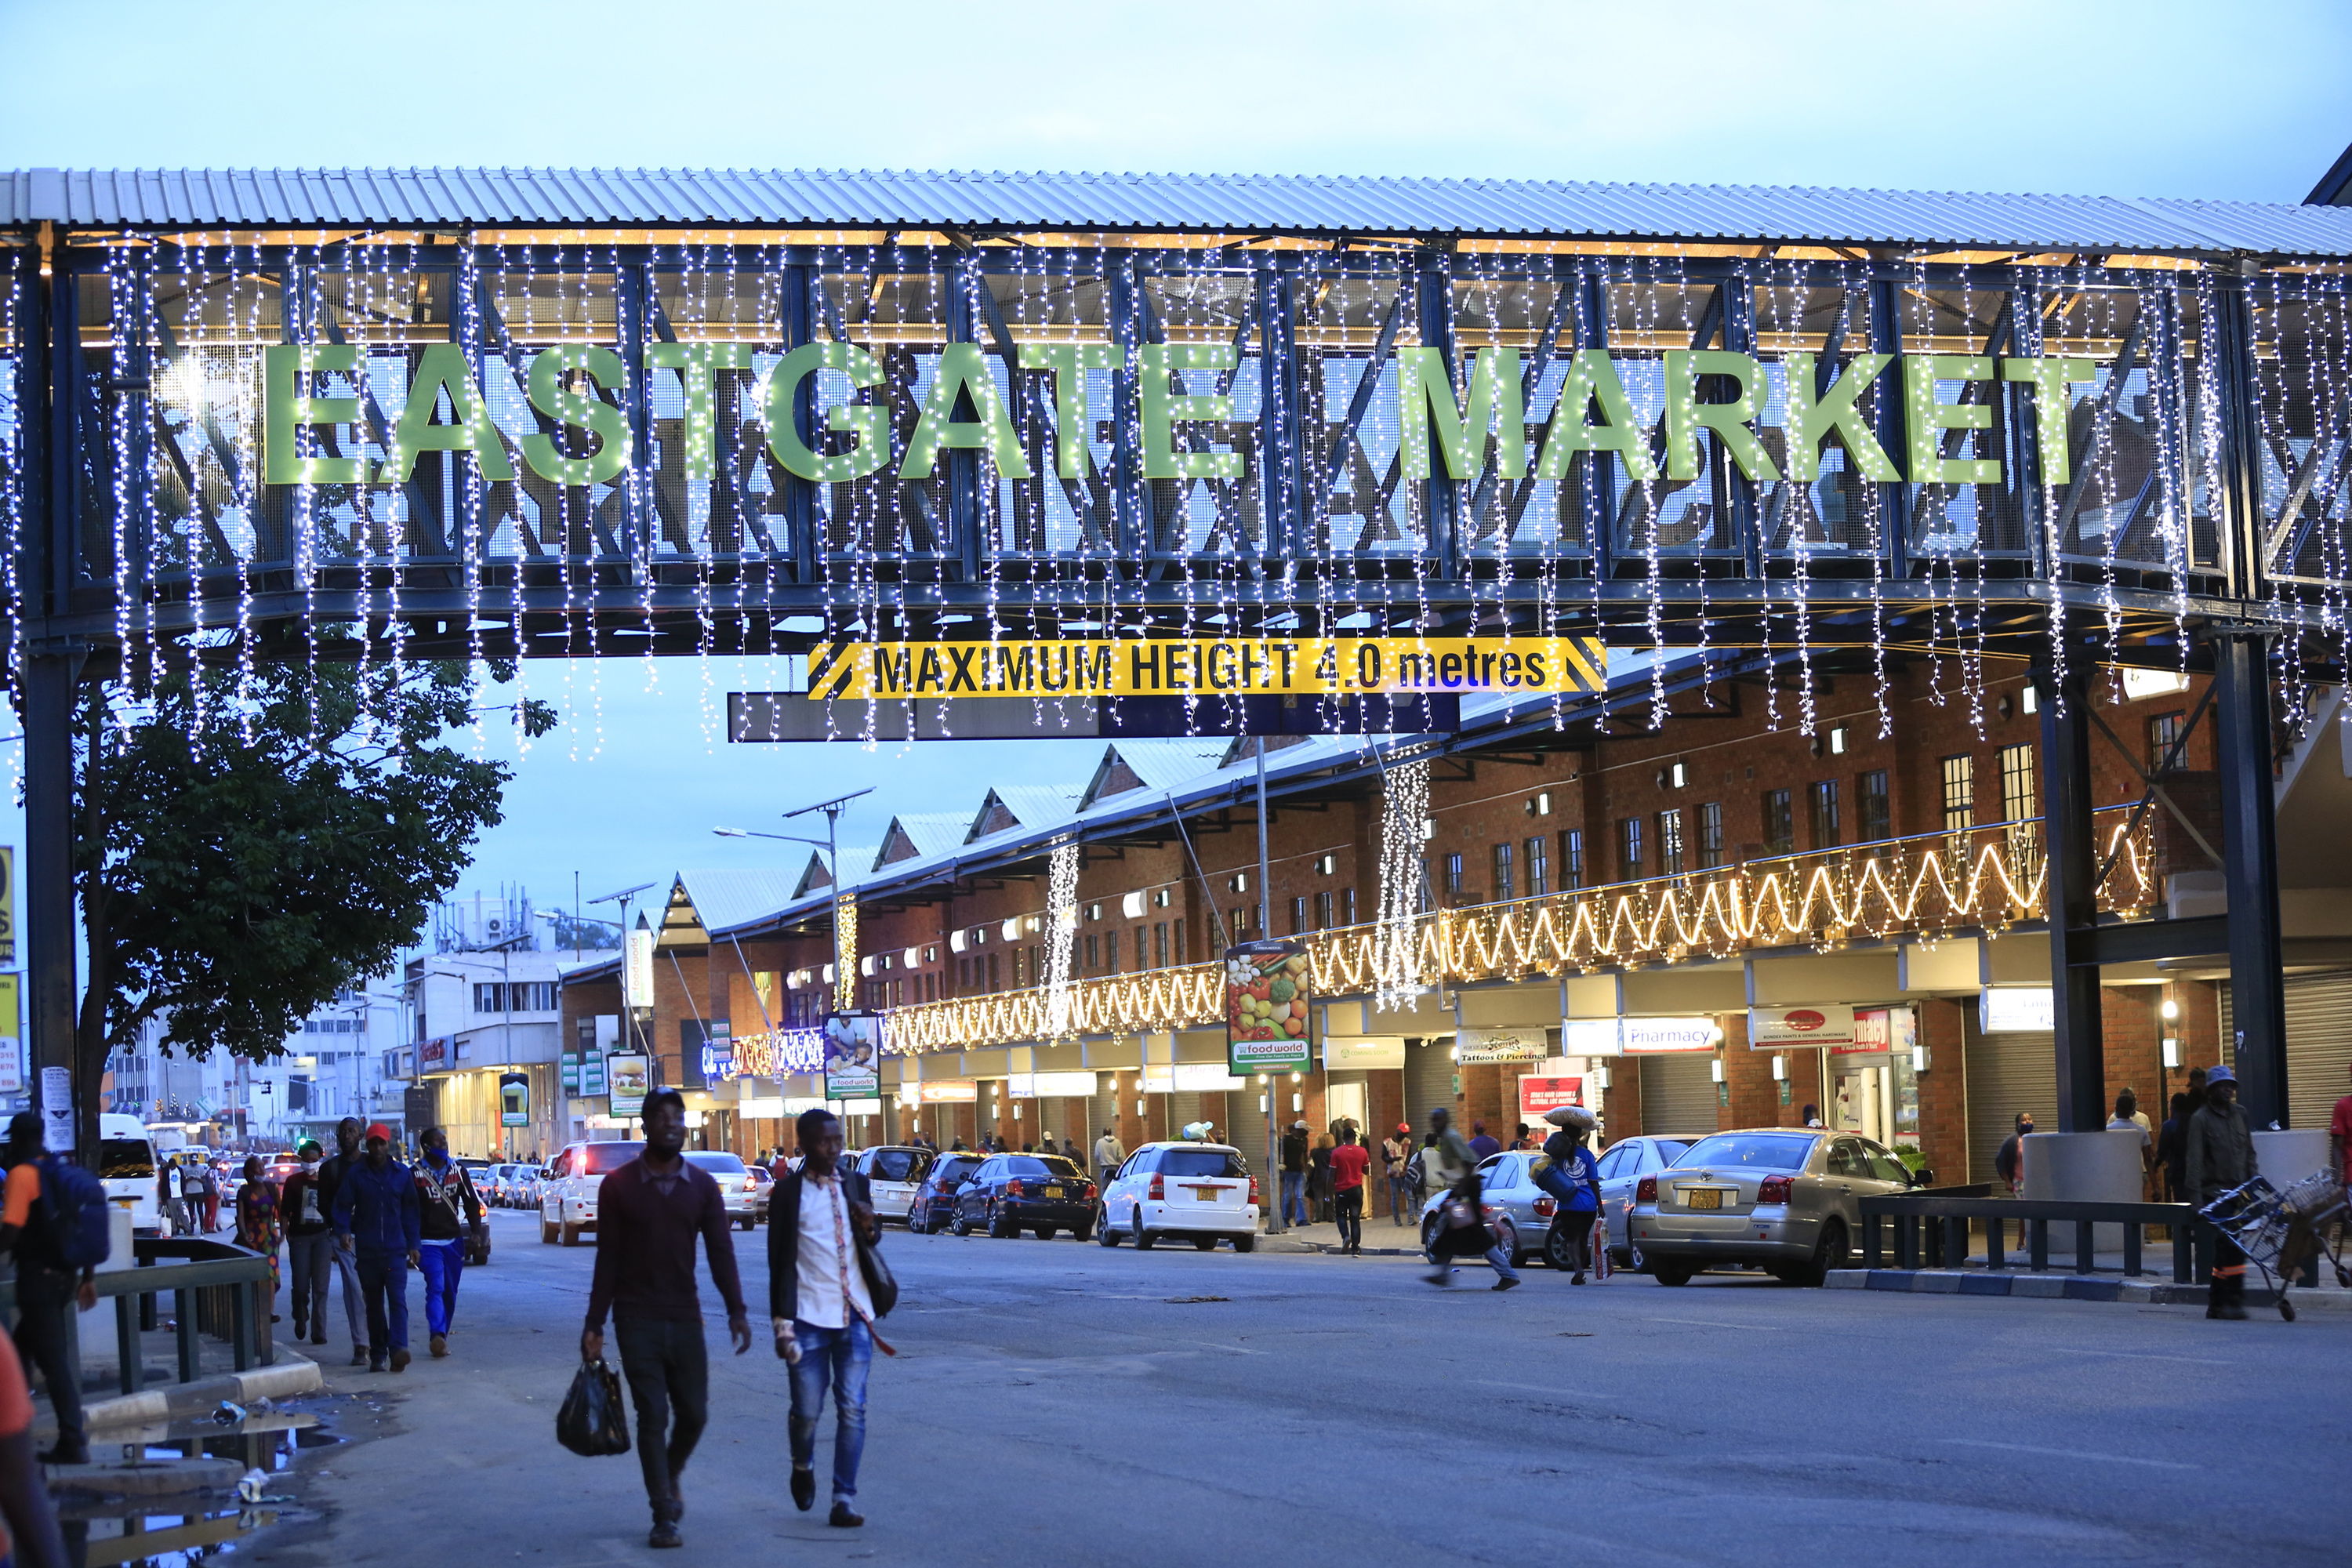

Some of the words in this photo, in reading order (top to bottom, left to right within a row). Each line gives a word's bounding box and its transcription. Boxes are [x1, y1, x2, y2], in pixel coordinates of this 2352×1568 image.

[263, 343, 1245, 485] EASTGATE
[1398, 346, 2096, 485] MARKET
[874, 644, 1111, 692] MAXIMUM
[1131, 643, 1300, 689] HEIGHT
[1314, 641, 1381, 688] 4.0
[1399, 643, 1546, 687] metres
[1632, 1029, 1711, 1045] Pharmacy
[1854, 1018, 1886, 1044] rmacy
[1247, 1044, 1272, 1054] food
[1274, 1044, 1303, 1053] world
[1506, 1052, 1545, 1061] Piercings
